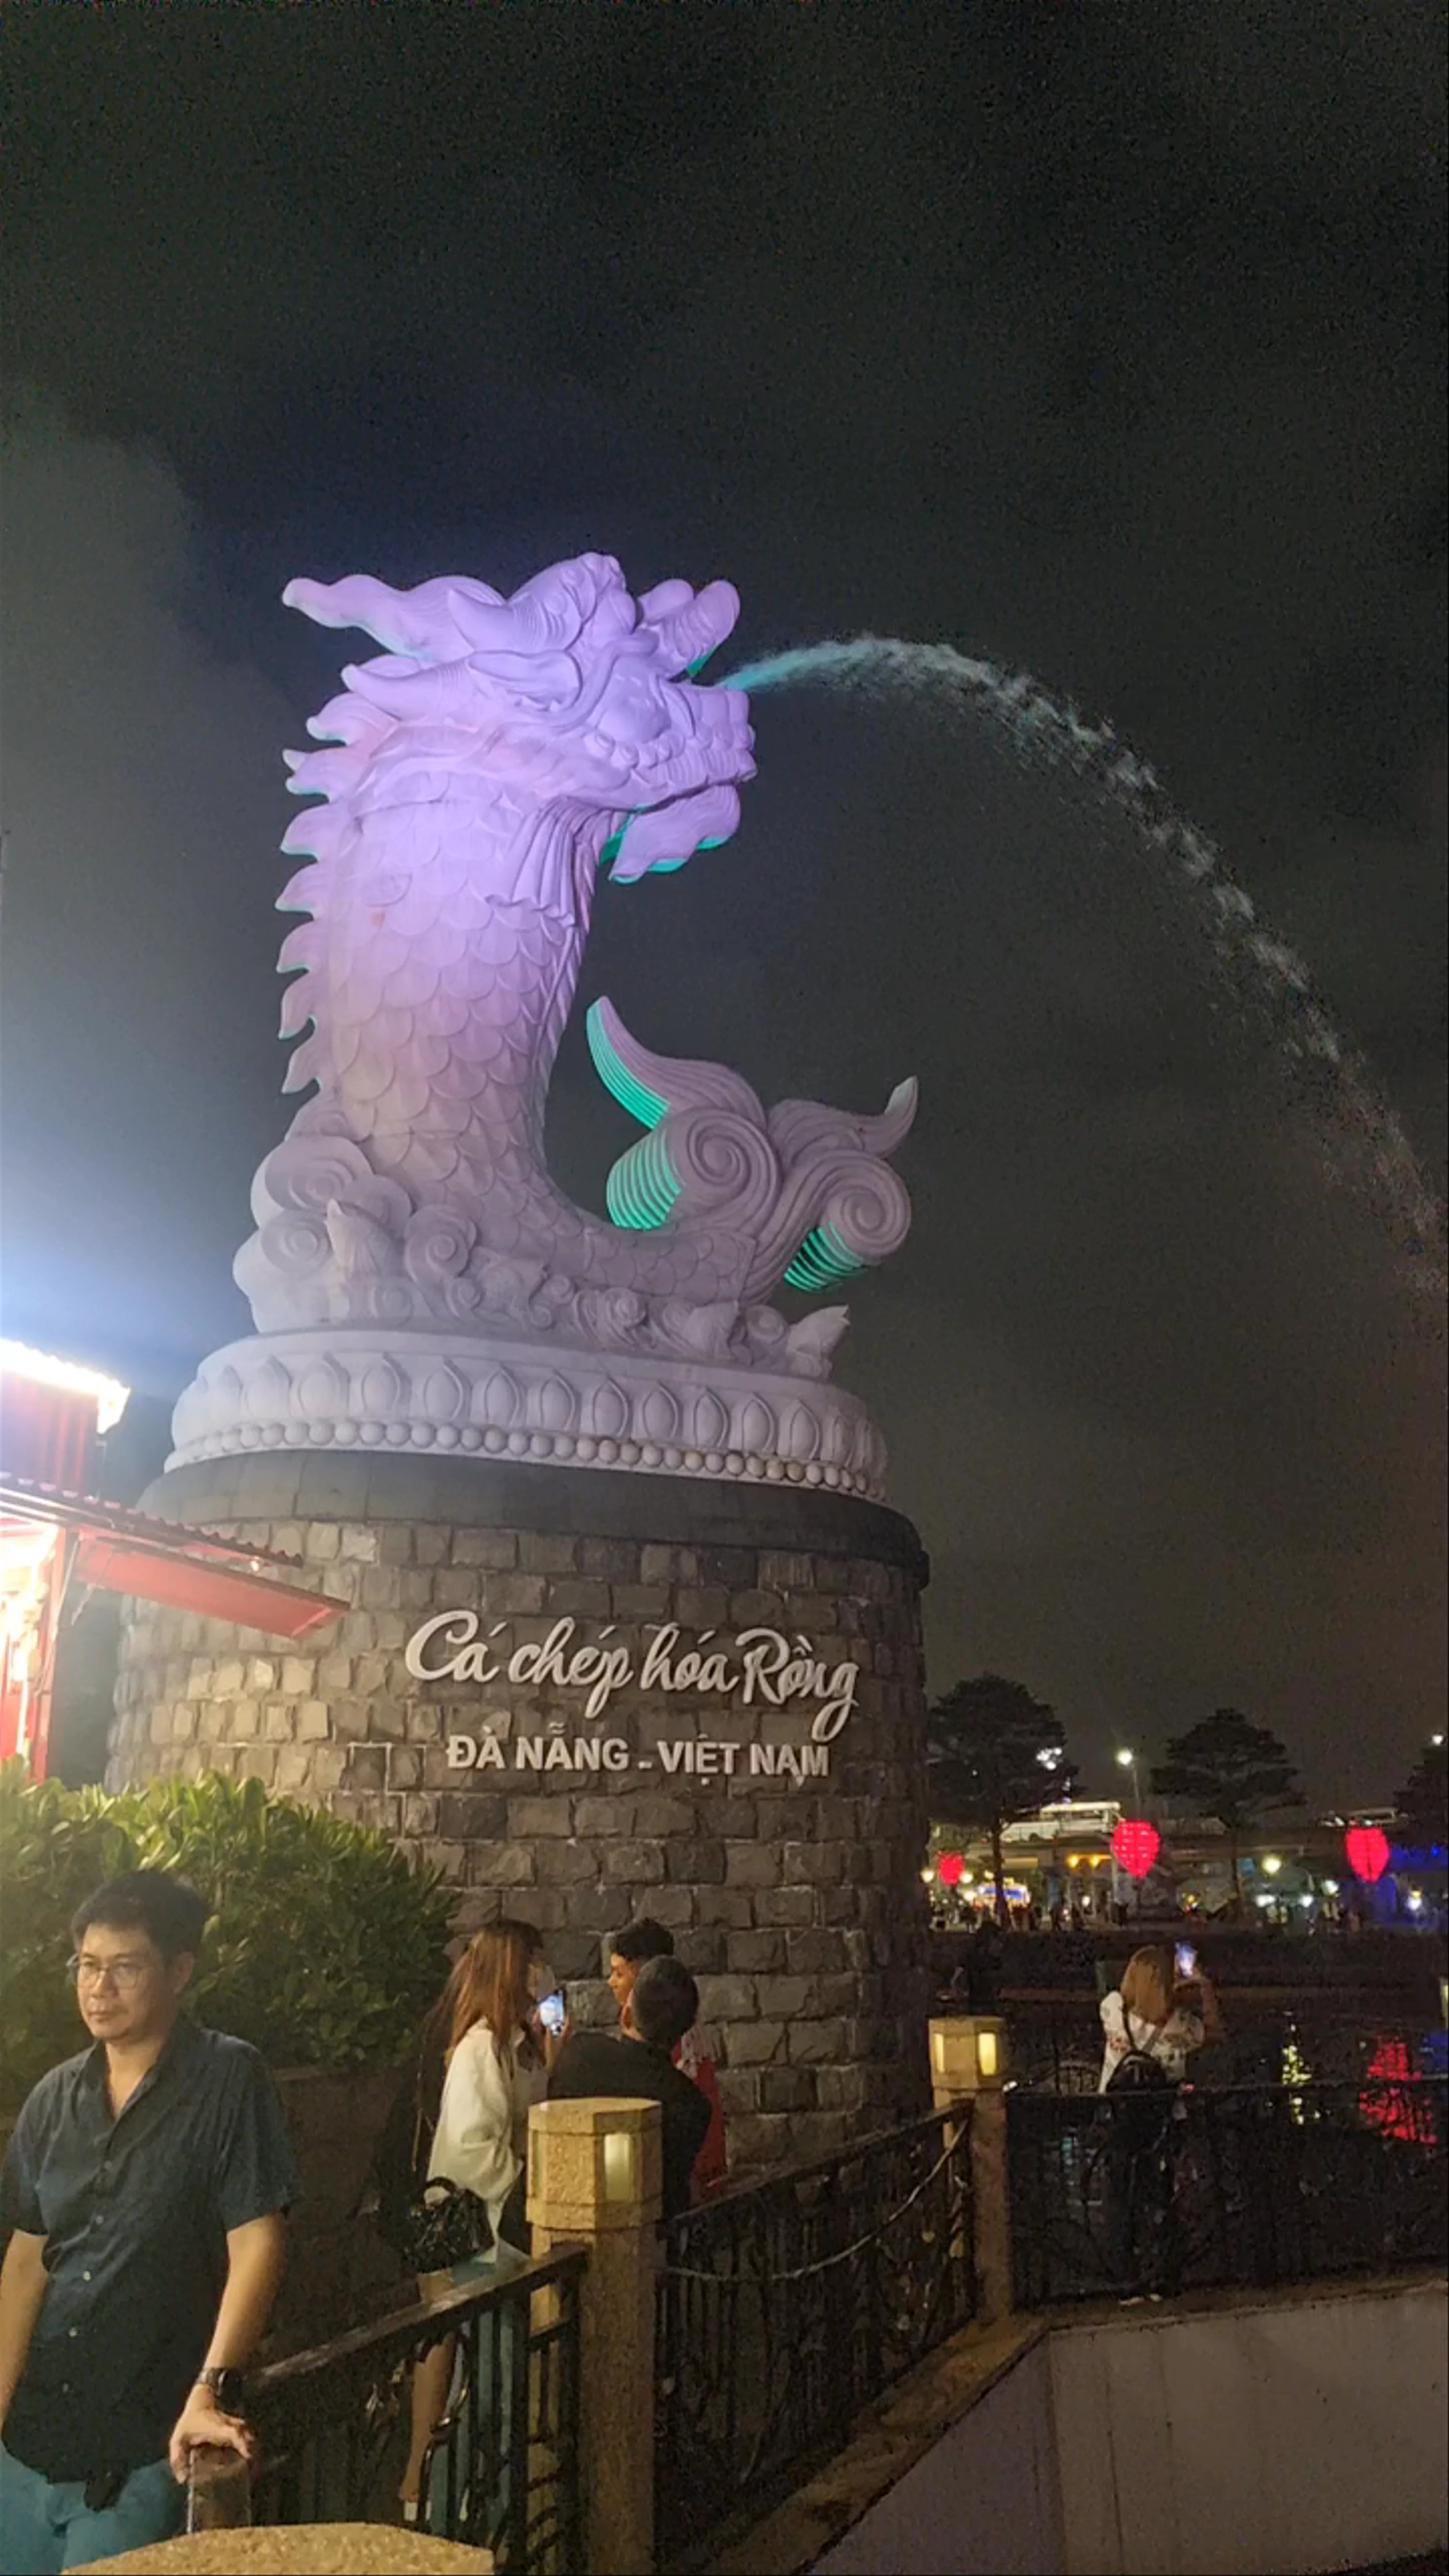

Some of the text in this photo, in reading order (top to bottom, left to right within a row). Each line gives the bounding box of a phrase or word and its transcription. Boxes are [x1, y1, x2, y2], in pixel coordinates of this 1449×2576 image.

[405, 1610, 859, 1741] Cá chép hóa Rồng
[446, 1726, 506, 1769] ĐÀ
[657, 1733, 740, 1785] VIỆT
[750, 1743, 829, 1786] NAM
